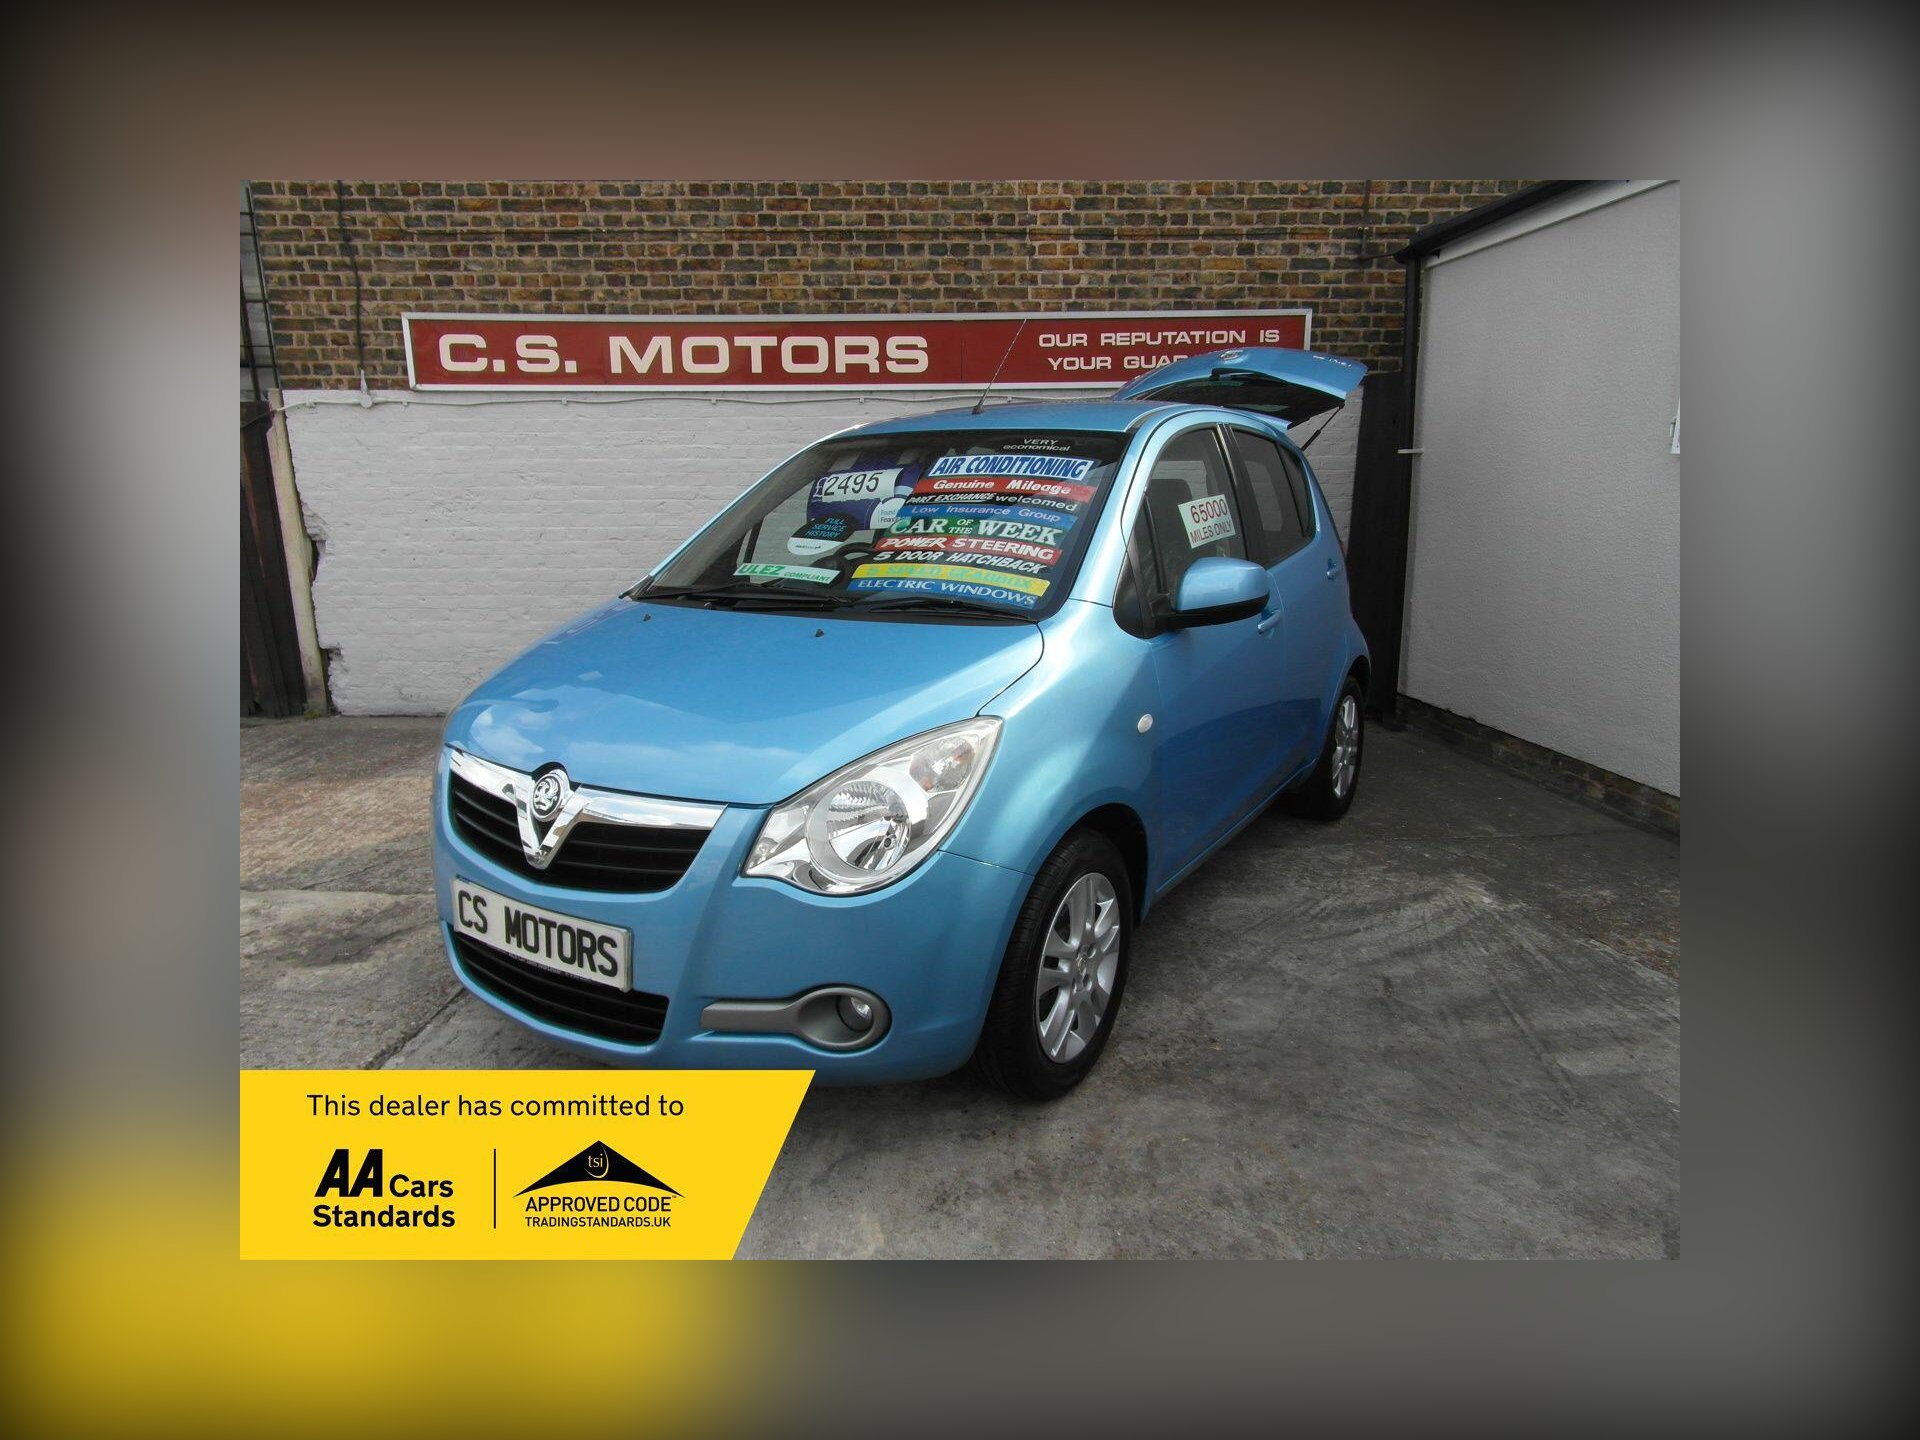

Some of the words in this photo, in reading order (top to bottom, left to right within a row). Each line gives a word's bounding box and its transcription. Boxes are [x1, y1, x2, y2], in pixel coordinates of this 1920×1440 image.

[1038, 333, 1088, 347] OUR
[1100, 330, 1246, 346] REPUTATION
[1259, 329, 1280, 343] IS
[438, 334, 578, 372] C.S.
[609, 336, 929, 374] MOTORS
[1048, 356, 1112, 371] YOUR
[1003, 444, 1071, 452] economical
[932, 457, 962, 475] AIR
[966, 456, 1089, 479] CONDITIONING
[933, 480, 995, 490] Genuine
[1006, 479, 1071, 496] Mileage
[906, 496, 933, 504] PART
[935, 493, 997, 502] EXCHANGE
[996, 495, 1078, 512] welcomed
[1190, 498, 1228, 524] 65000
[911, 506, 939, 514] Low
[946, 506, 1010, 516] Insurance
[1018, 508, 1061, 523] Group
[890, 518, 949, 535] CAR
[949, 527, 973, 535] THE
[977, 519, 1063, 546] WEEK
[1190, 525, 1214, 544] MILES
[1214, 520, 1232, 536] ONLY
[881, 537, 948, 548] POWER
[952, 538, 1055, 560] STEERING
[739, 564, 786, 576] ULEZ
[784, 571, 832, 583] COMPLIANT
[873, 551, 891, 561] 5
[895, 551, 944, 561] DOOR
[946, 552, 1047, 574] HATCHBACK
[858, 579, 935, 590] ELECTRIC
[941, 582, 1037, 605] WINDOWS
[458, 889, 488, 934] CS
[504, 906, 618, 978] MOTORS
